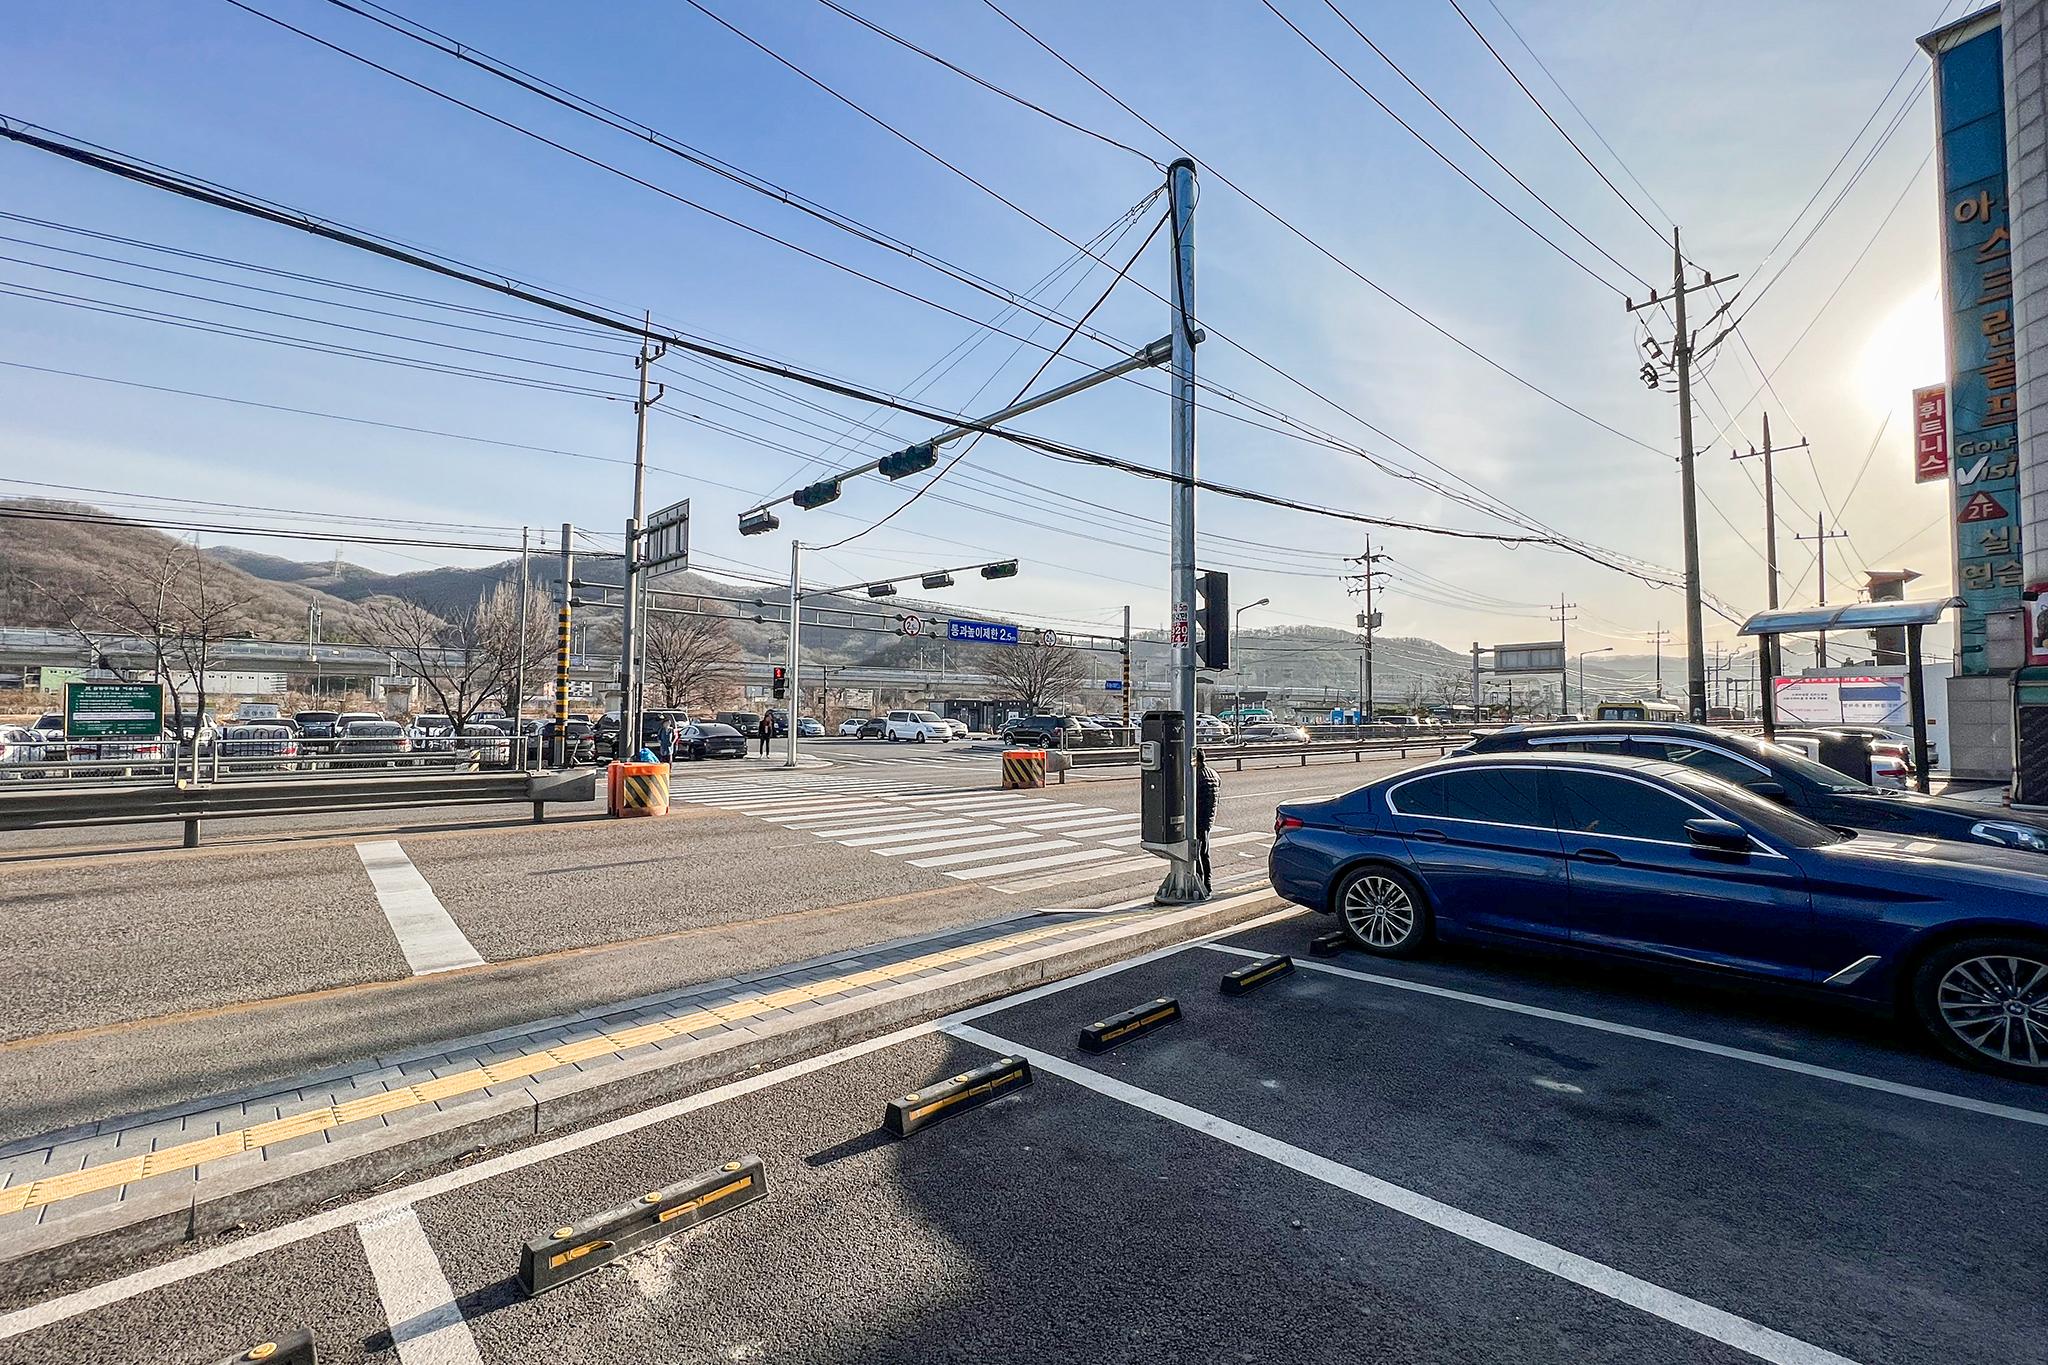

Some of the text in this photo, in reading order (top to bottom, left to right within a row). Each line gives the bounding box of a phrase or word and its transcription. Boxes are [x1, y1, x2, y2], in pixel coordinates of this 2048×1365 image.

[1919, 400, 1946, 472] 휘트니스
[1957, 437, 2017, 457] GOLF
[1968, 503, 1994, 519] 2F
[950, 623, 998, 640] 통과높이제한
